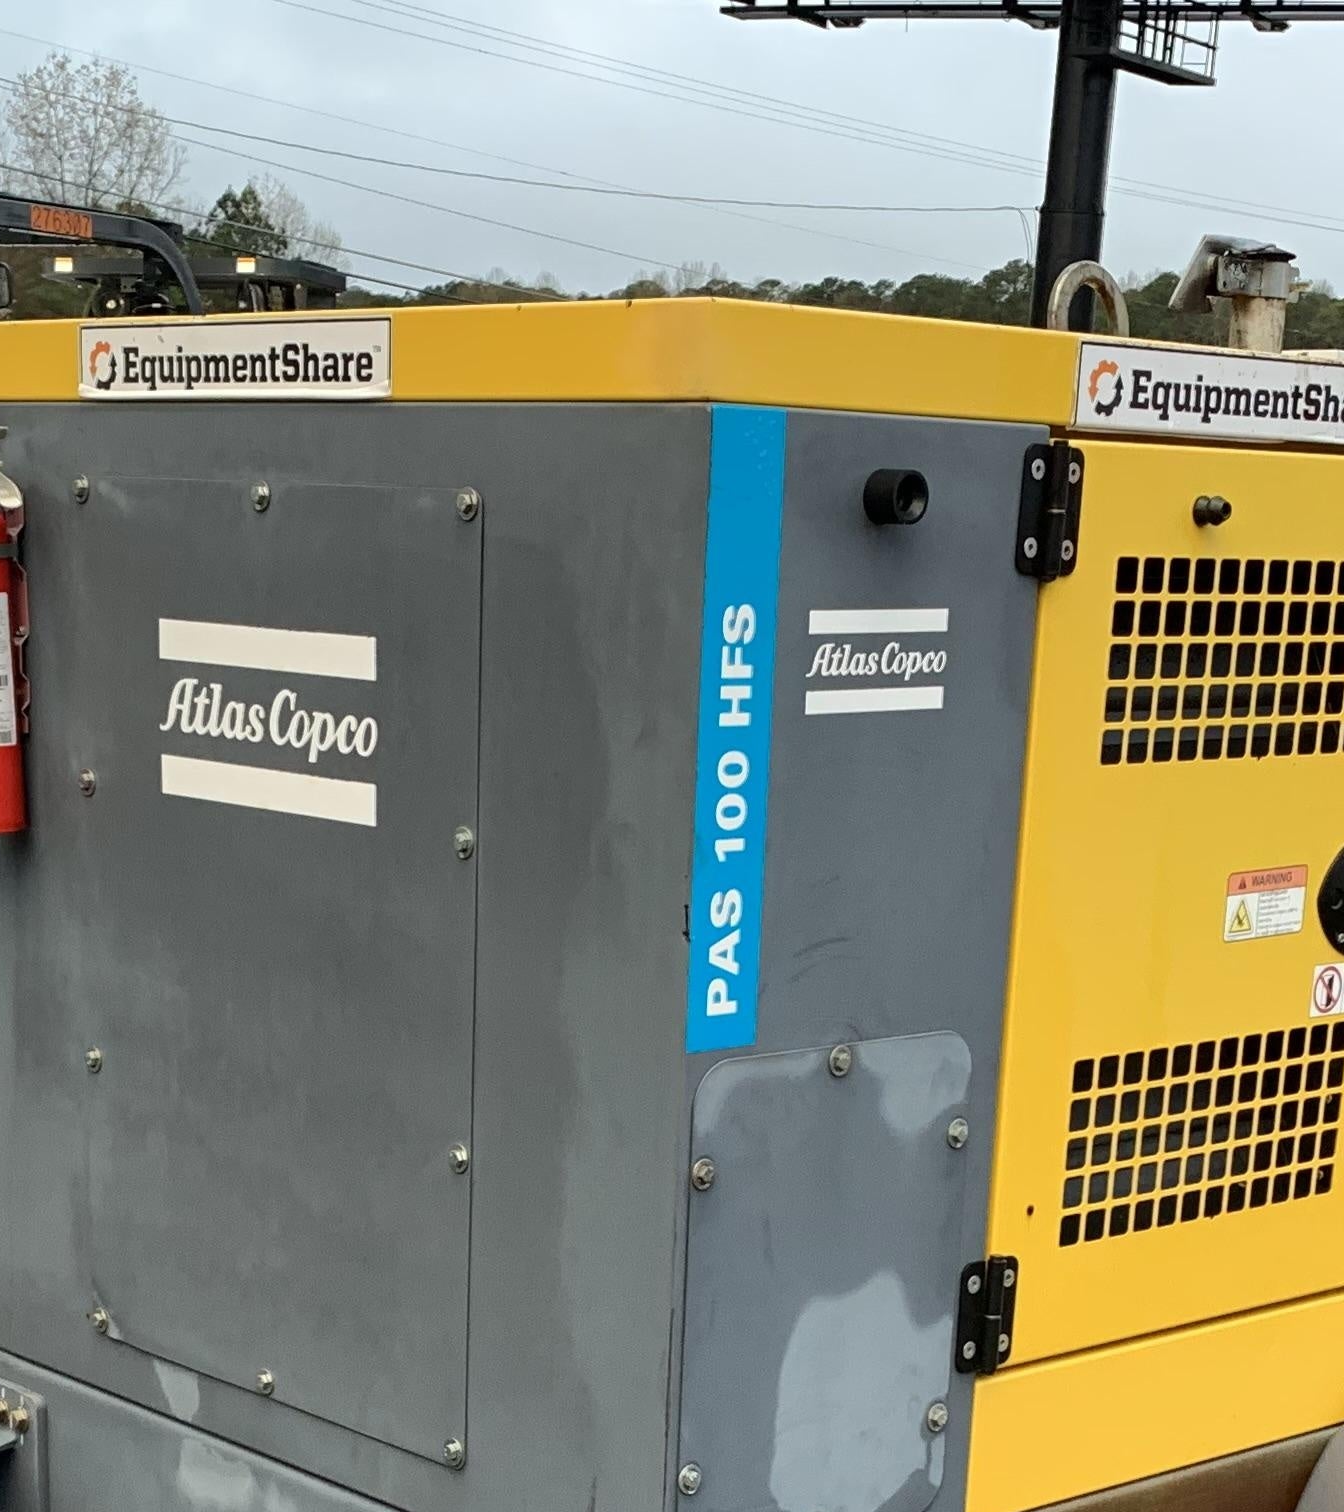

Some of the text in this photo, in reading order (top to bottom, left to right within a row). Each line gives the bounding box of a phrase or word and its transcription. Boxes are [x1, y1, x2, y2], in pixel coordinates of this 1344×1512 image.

[32, 204, 91, 234] 276307
[122, 343, 374, 391] EquipmentShare
[805, 641, 948, 682] Atlas Copco
[159, 677, 379, 764] Atlas Copco
[705, 602, 757, 1018] PAS 100 HFS
[1251, 871, 1293, 887] WARNING
